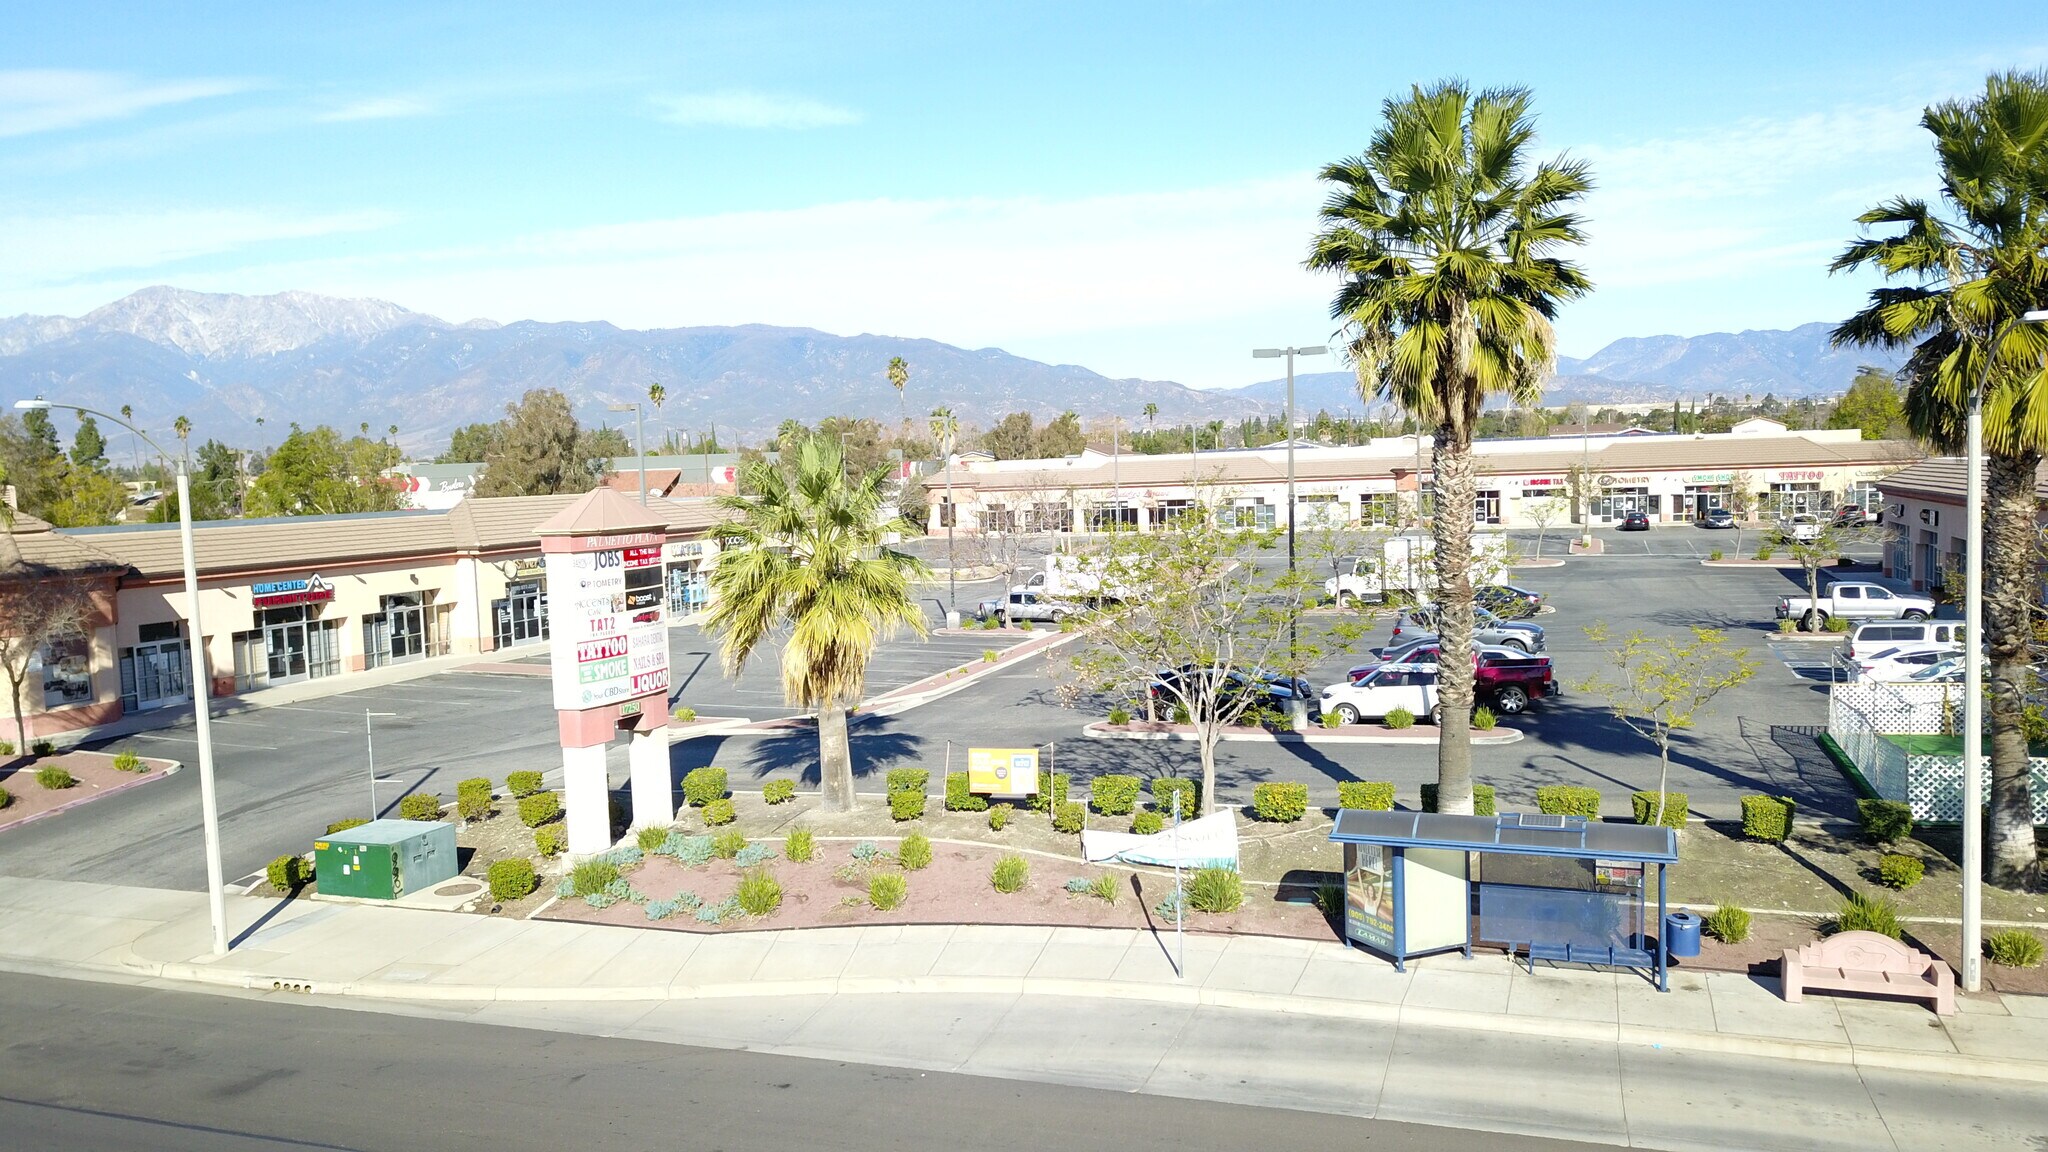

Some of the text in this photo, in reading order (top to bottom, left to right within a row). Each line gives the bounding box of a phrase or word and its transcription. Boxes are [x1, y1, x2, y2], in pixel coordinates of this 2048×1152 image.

[1779, 470, 1824, 481] TATTOO
[587, 534, 633, 548] PALMETTO
[629, 549, 639, 557] ALL
[639, 548, 648, 556] THE
[594, 550, 621, 571] JOBS
[253, 579, 306, 593] HOME CENTER
[635, 593, 652, 602] boost
[578, 636, 627, 660] TATTOO
[594, 659, 627, 682] SMOKE
[631, 669, 668, 694] LIQUOR
[604, 686, 619, 698] CBD
[1357, 929, 1386, 946] LAMAR
